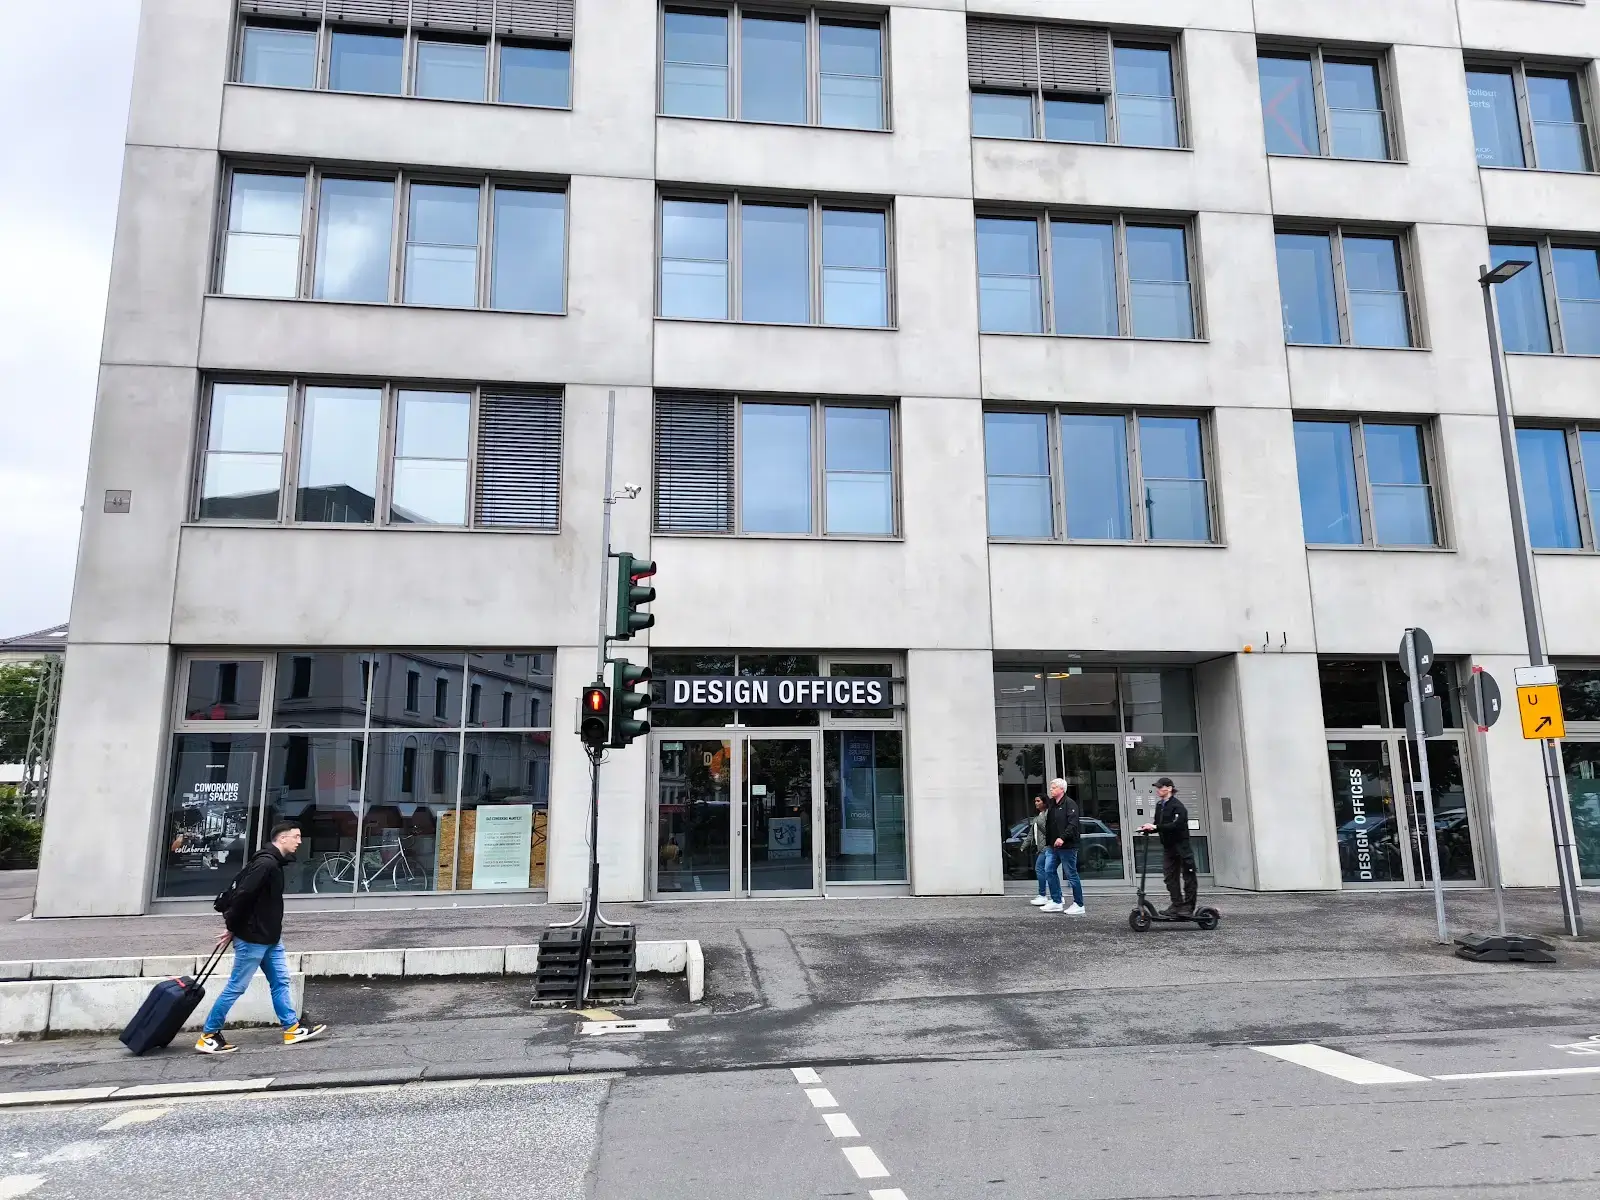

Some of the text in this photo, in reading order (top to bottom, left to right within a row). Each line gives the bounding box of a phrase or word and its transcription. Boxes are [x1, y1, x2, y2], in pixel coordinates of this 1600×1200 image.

[674, 680, 882, 704] DESIGN OFFICES
[1528, 694, 1538, 705] U
[195, 783, 239, 793] COWORKING
[1130, 777, 1136, 790] 1
[208, 792, 239, 802] SPACES
[1350, 768, 1373, 880] DESIGN OFFICES
[174, 844, 211, 854] collaborate
